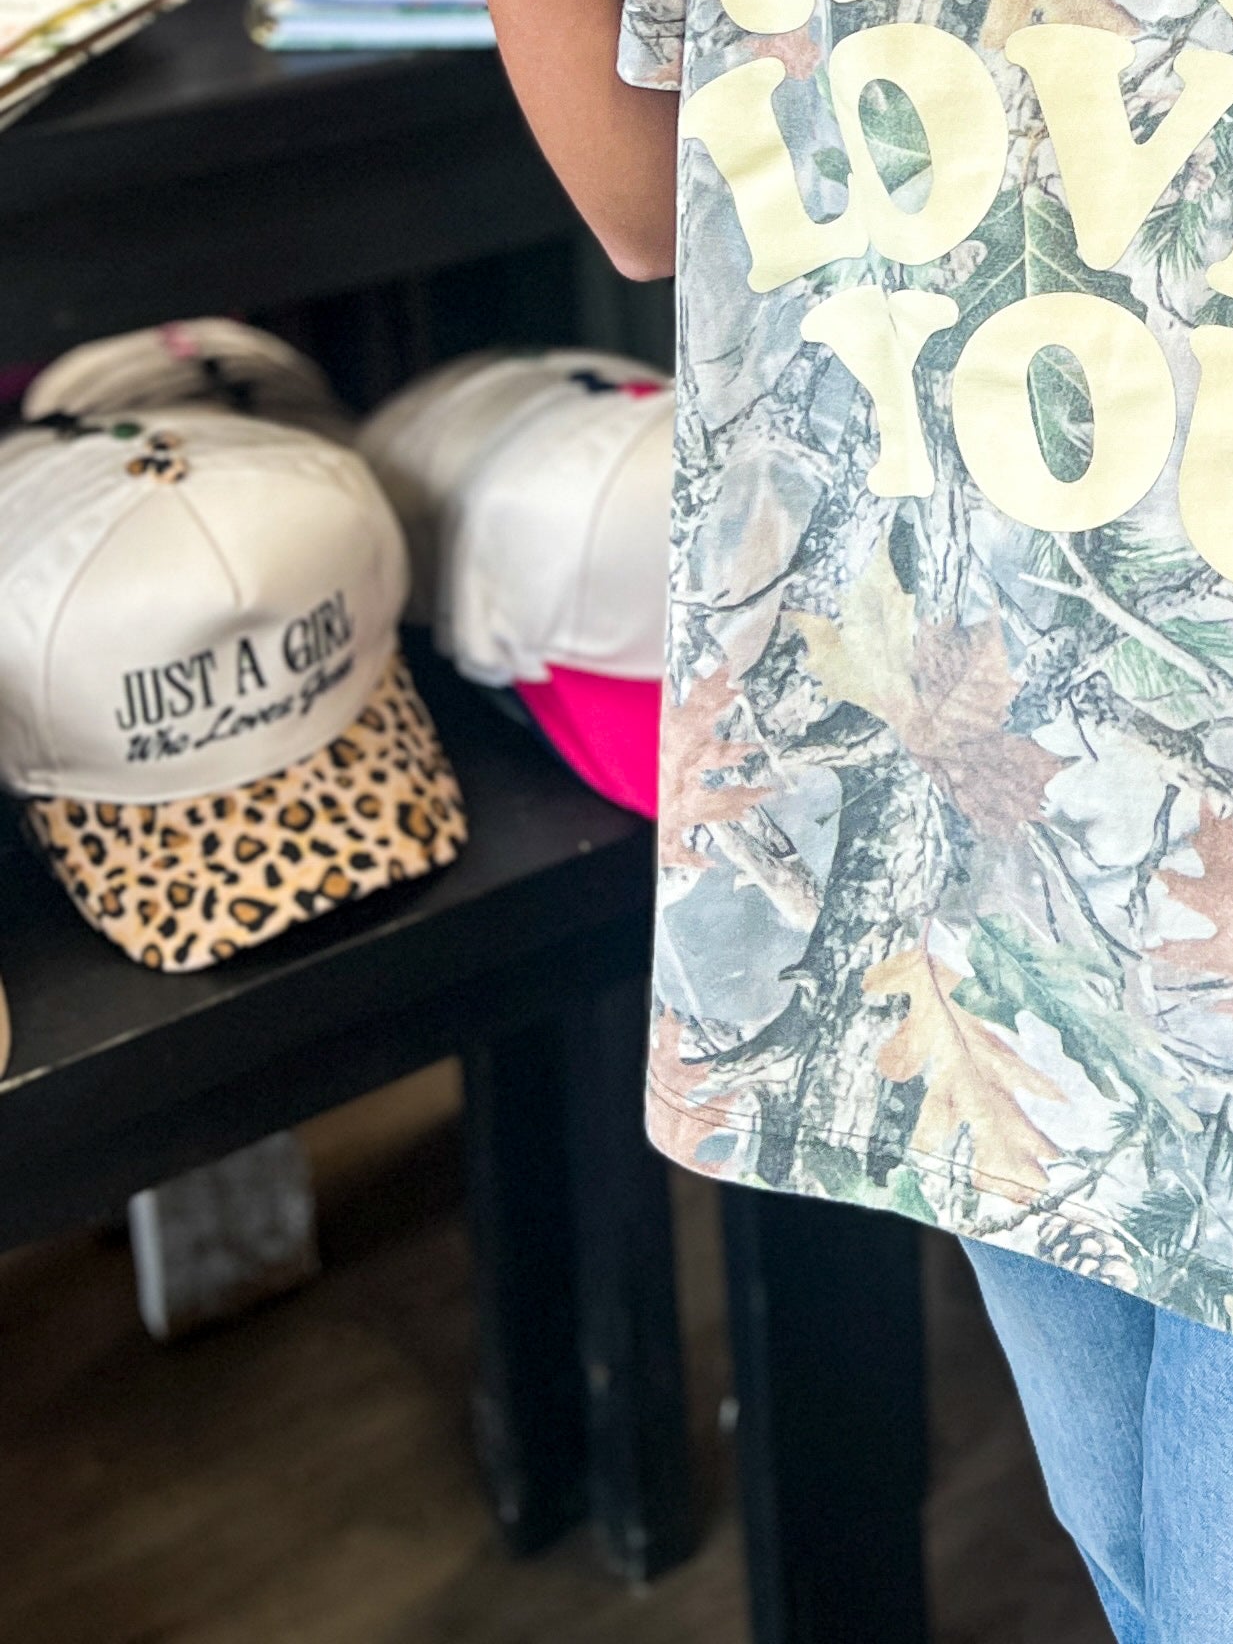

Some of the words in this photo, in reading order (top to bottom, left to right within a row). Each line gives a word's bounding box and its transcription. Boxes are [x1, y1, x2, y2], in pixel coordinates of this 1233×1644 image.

[116, 649, 216, 731] JUST
[236, 637, 267, 695] A
[281, 590, 353, 674] GIRL
